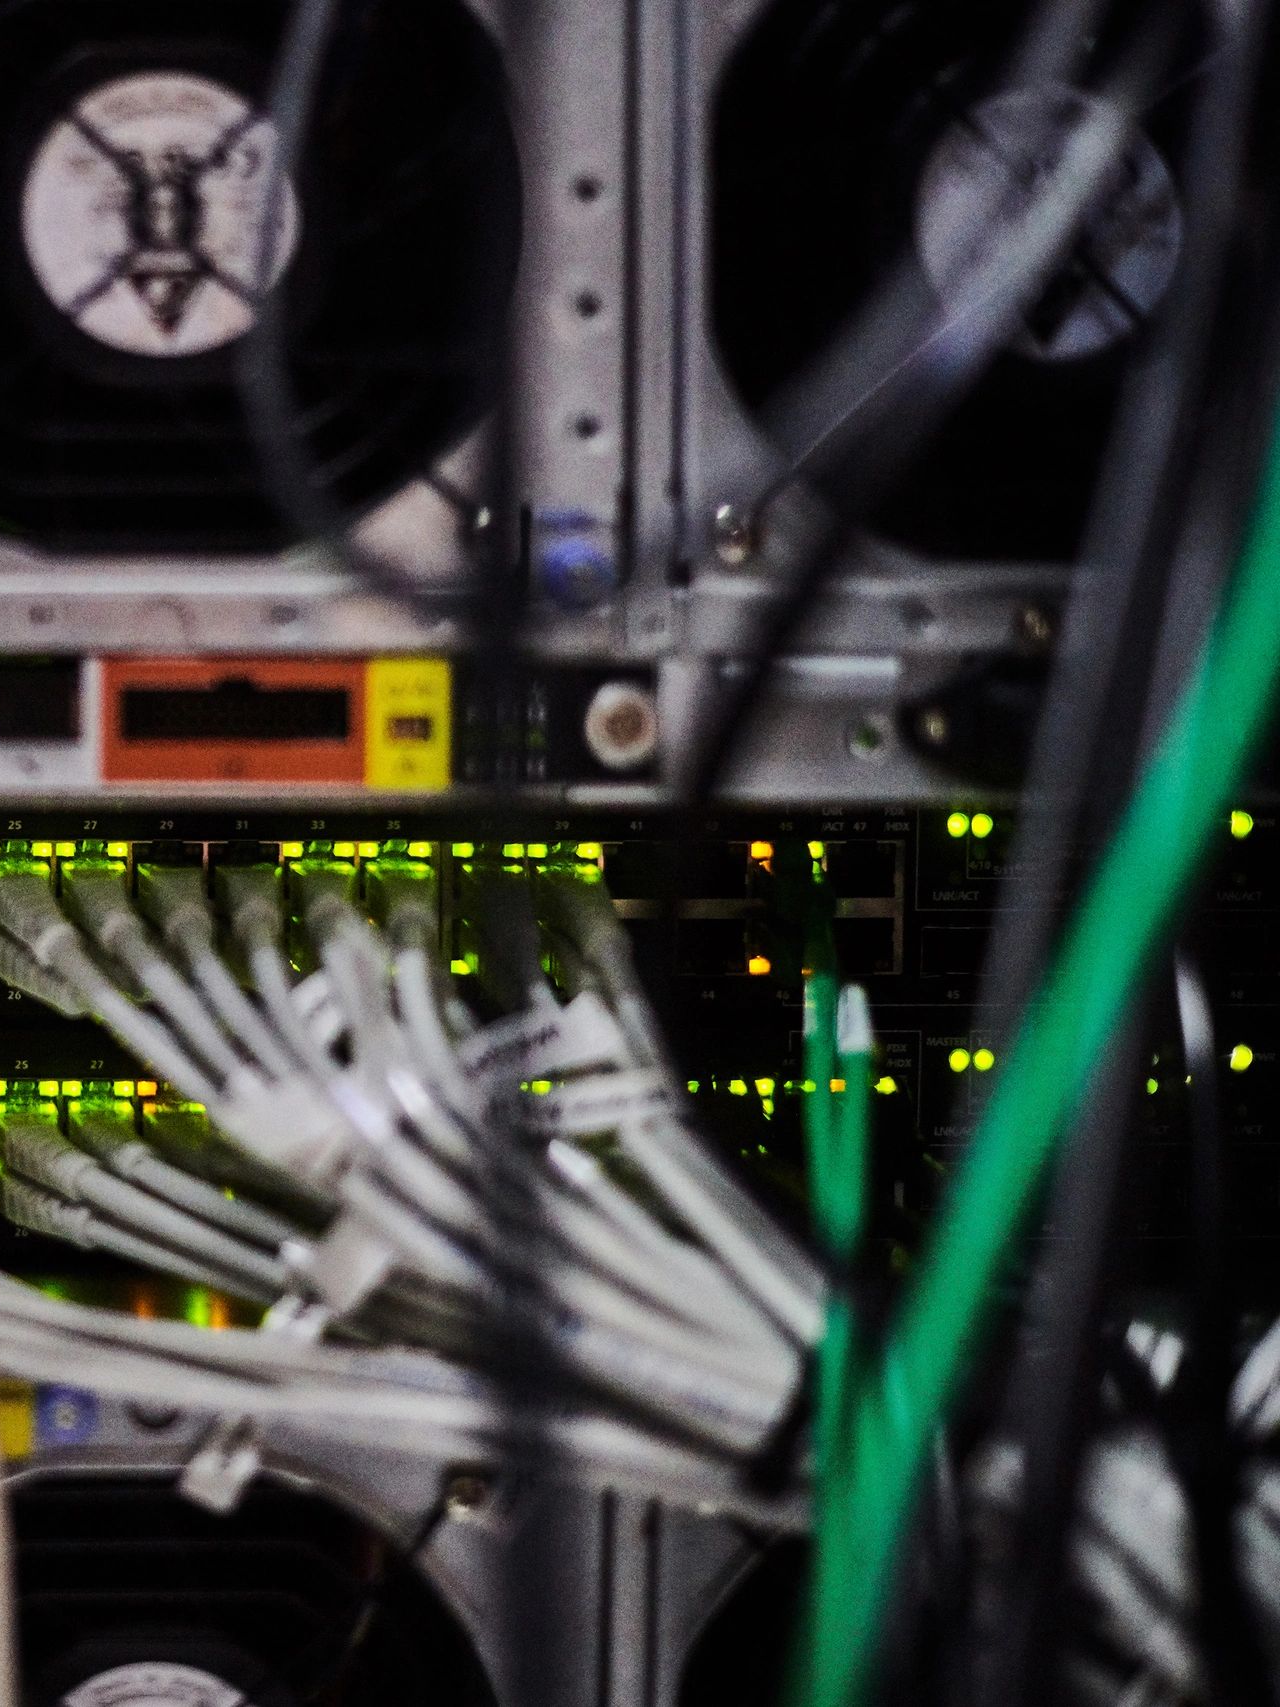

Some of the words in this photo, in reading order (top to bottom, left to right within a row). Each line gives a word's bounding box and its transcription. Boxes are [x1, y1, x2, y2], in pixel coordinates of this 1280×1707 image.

[8, 819, 22, 831] 25
[83, 819, 98, 831] 27
[159, 819, 174, 831] 29
[234, 819, 249, 831] 31
[310, 819, 326, 831] 33
[386, 819, 401, 831] 35
[554, 819, 569, 831] 39
[7, 989, 22, 1000] 26
[14, 1060, 29, 1070] 25
[90, 1060, 105, 1070] 27
